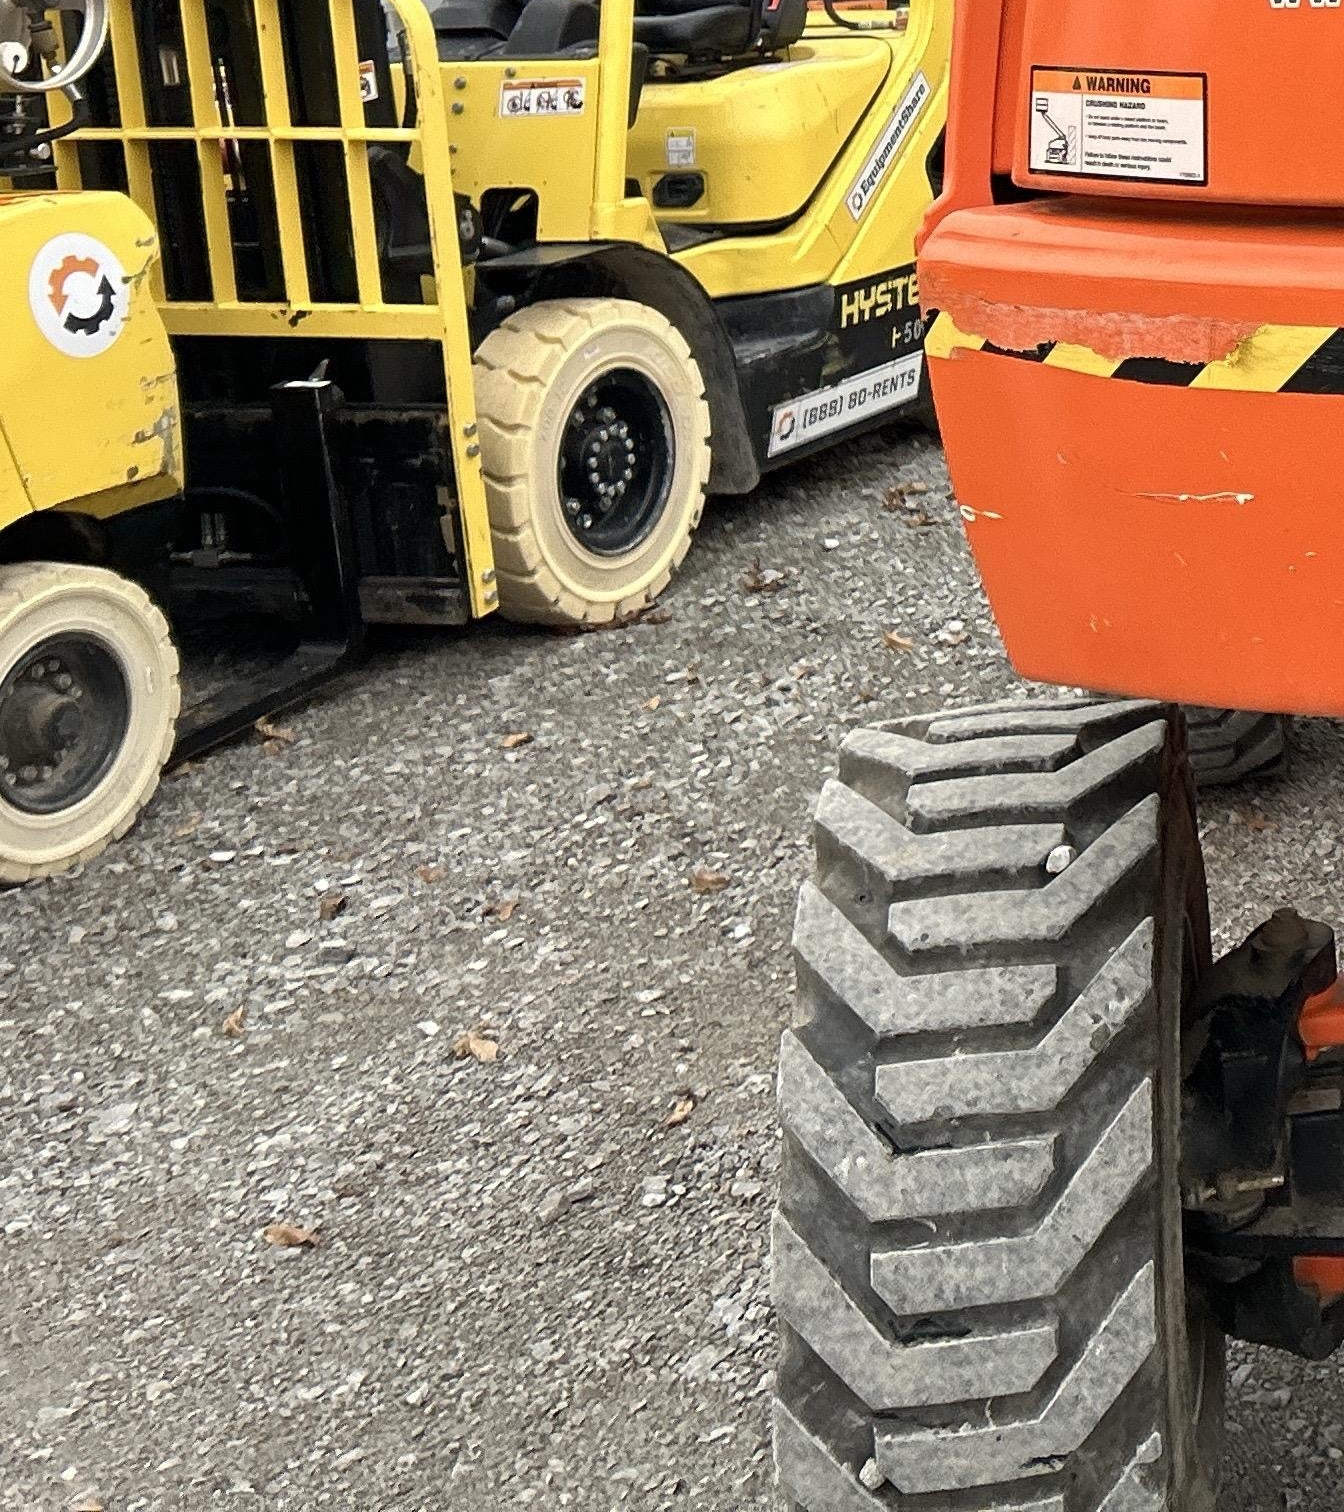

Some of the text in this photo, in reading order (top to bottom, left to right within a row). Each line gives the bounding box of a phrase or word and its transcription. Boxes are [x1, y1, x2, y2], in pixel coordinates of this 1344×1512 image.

[1085, 76, 1151, 93] WARNING
[860, 83, 926, 197] EquipmentShare
[841, 273, 920, 328] HYSTE
[802, 368, 916, 429] (888) 80-RENTS
